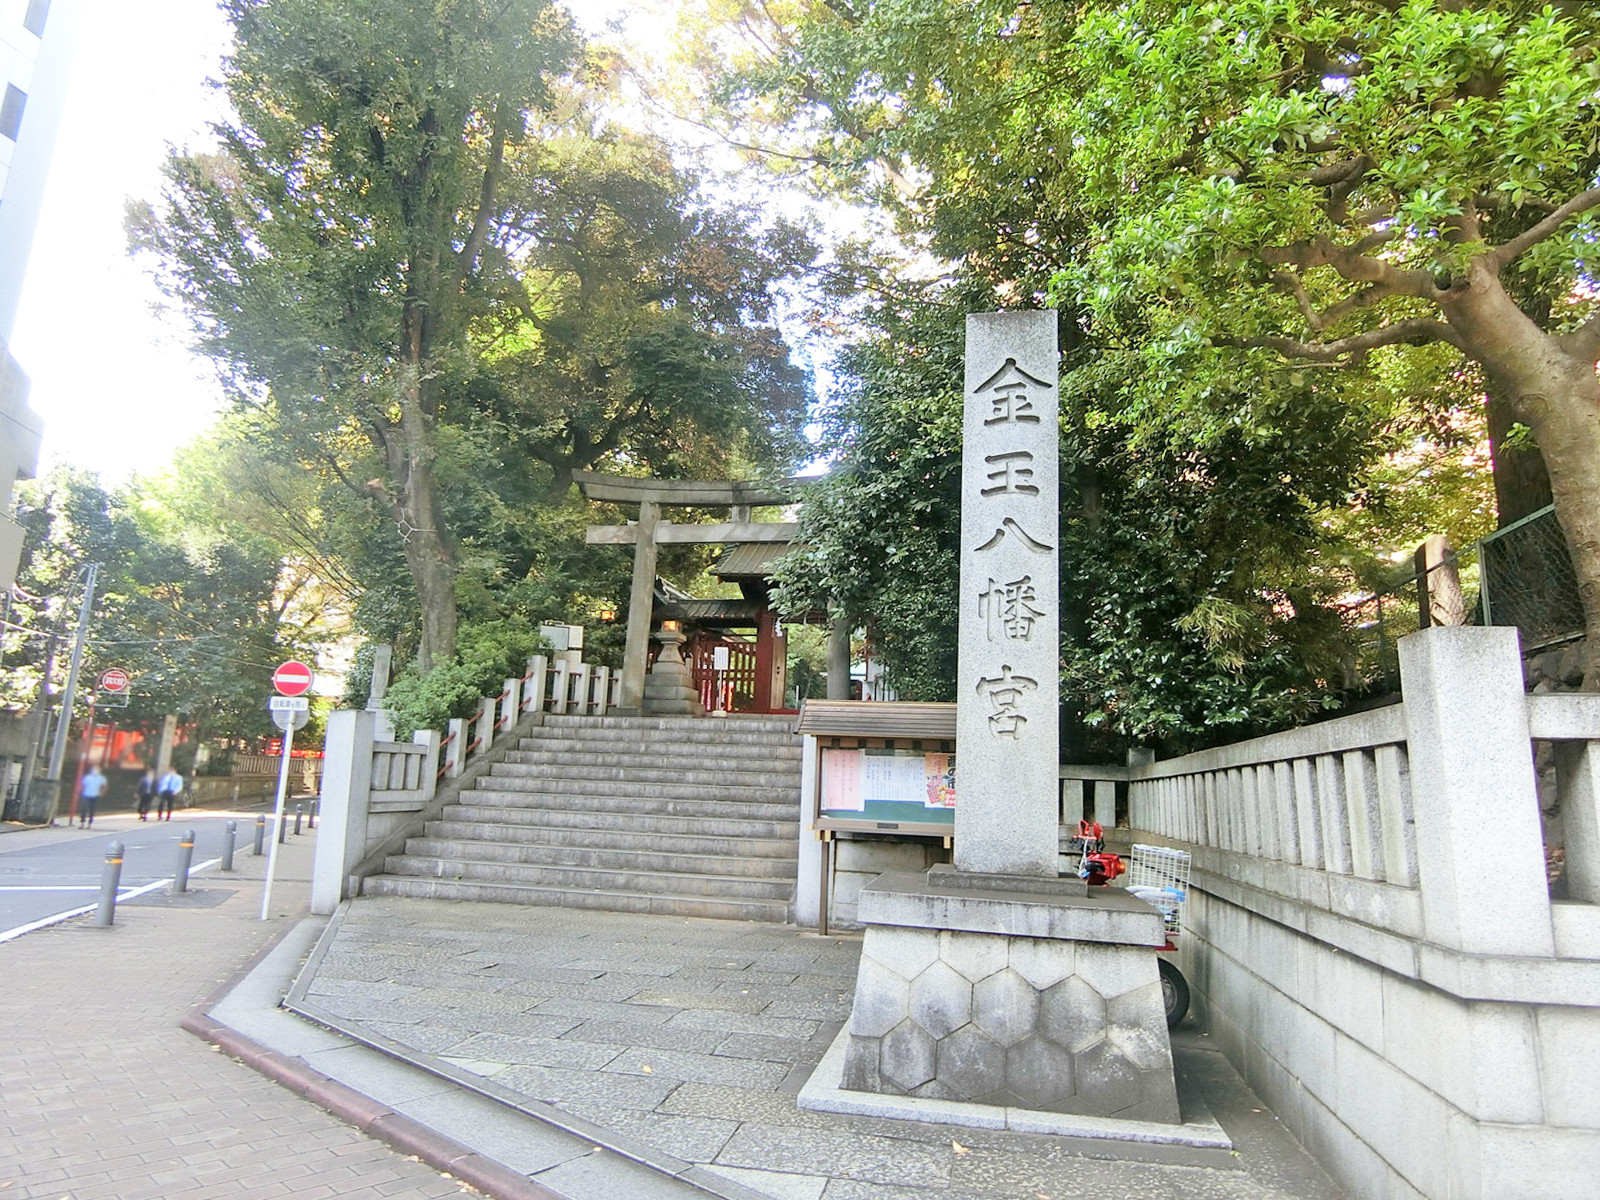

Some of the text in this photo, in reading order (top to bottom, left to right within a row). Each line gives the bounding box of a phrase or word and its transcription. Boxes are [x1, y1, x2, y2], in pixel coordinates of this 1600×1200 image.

[973, 357, 1054, 740] 金王八幡宮
